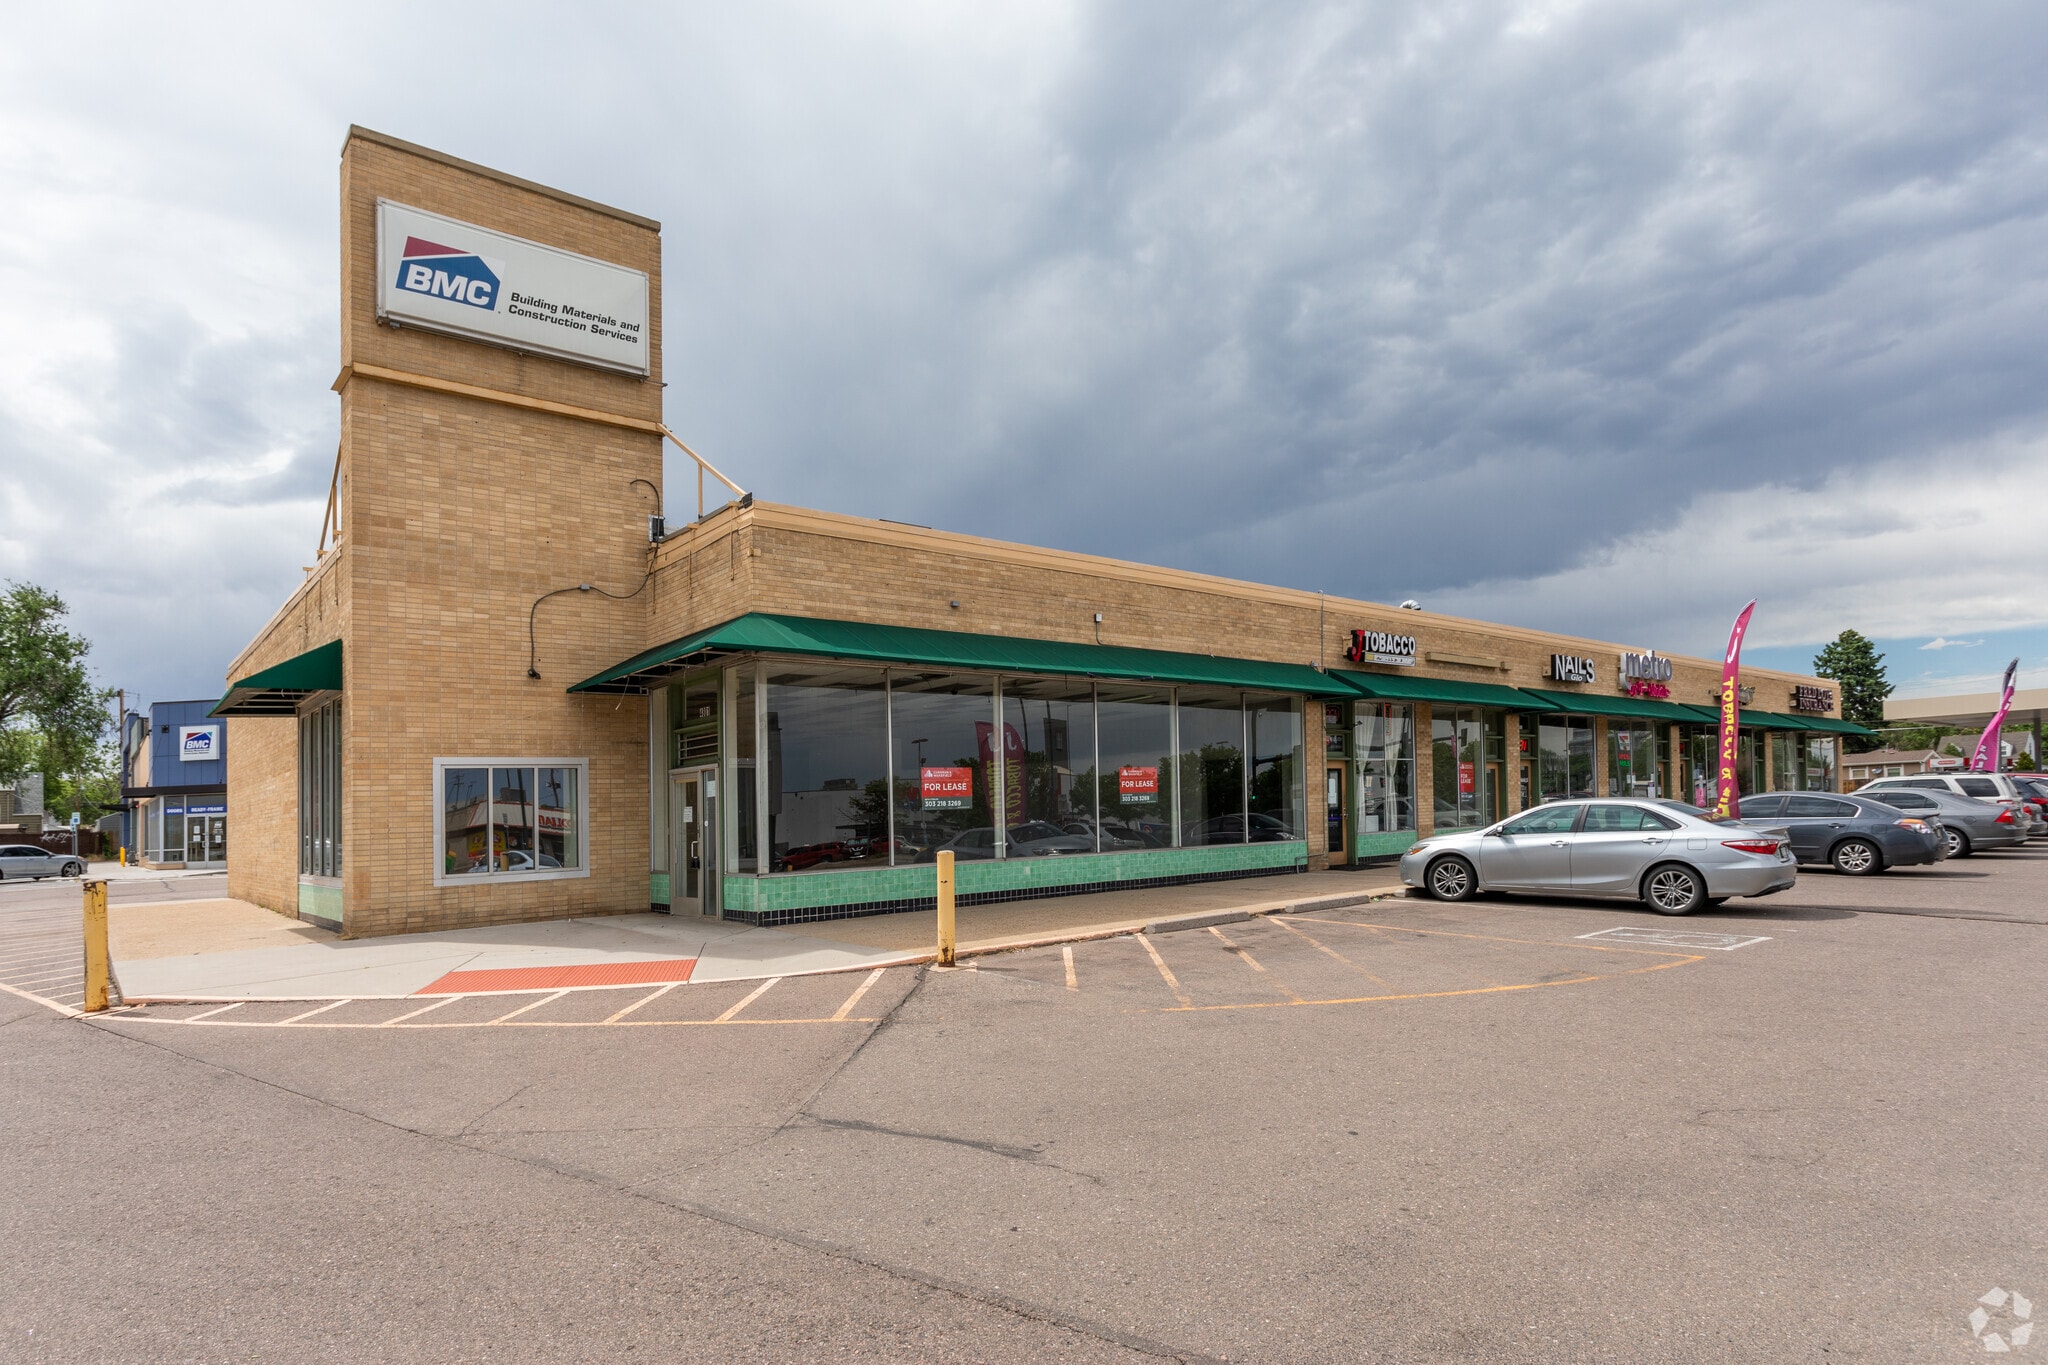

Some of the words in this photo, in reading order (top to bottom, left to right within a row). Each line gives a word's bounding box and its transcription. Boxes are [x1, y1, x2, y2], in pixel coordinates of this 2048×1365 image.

[405, 263, 492, 306] BMC
[508, 304, 587, 331] Construction
[590, 324, 638, 344] Services
[510, 292, 558, 314] Building
[561, 305, 617, 327] Materials
[620, 321, 640, 333] and
[1365, 631, 1416, 655] TOBACCO
[1555, 654, 1596, 683] NAILS
[1622, 650, 1673, 681] metro
[186, 739, 210, 749] BMC
[924, 783, 941, 791] FOR
[942, 782, 967, 791] LEASE
[1135, 780, 1154, 788] LEASE
